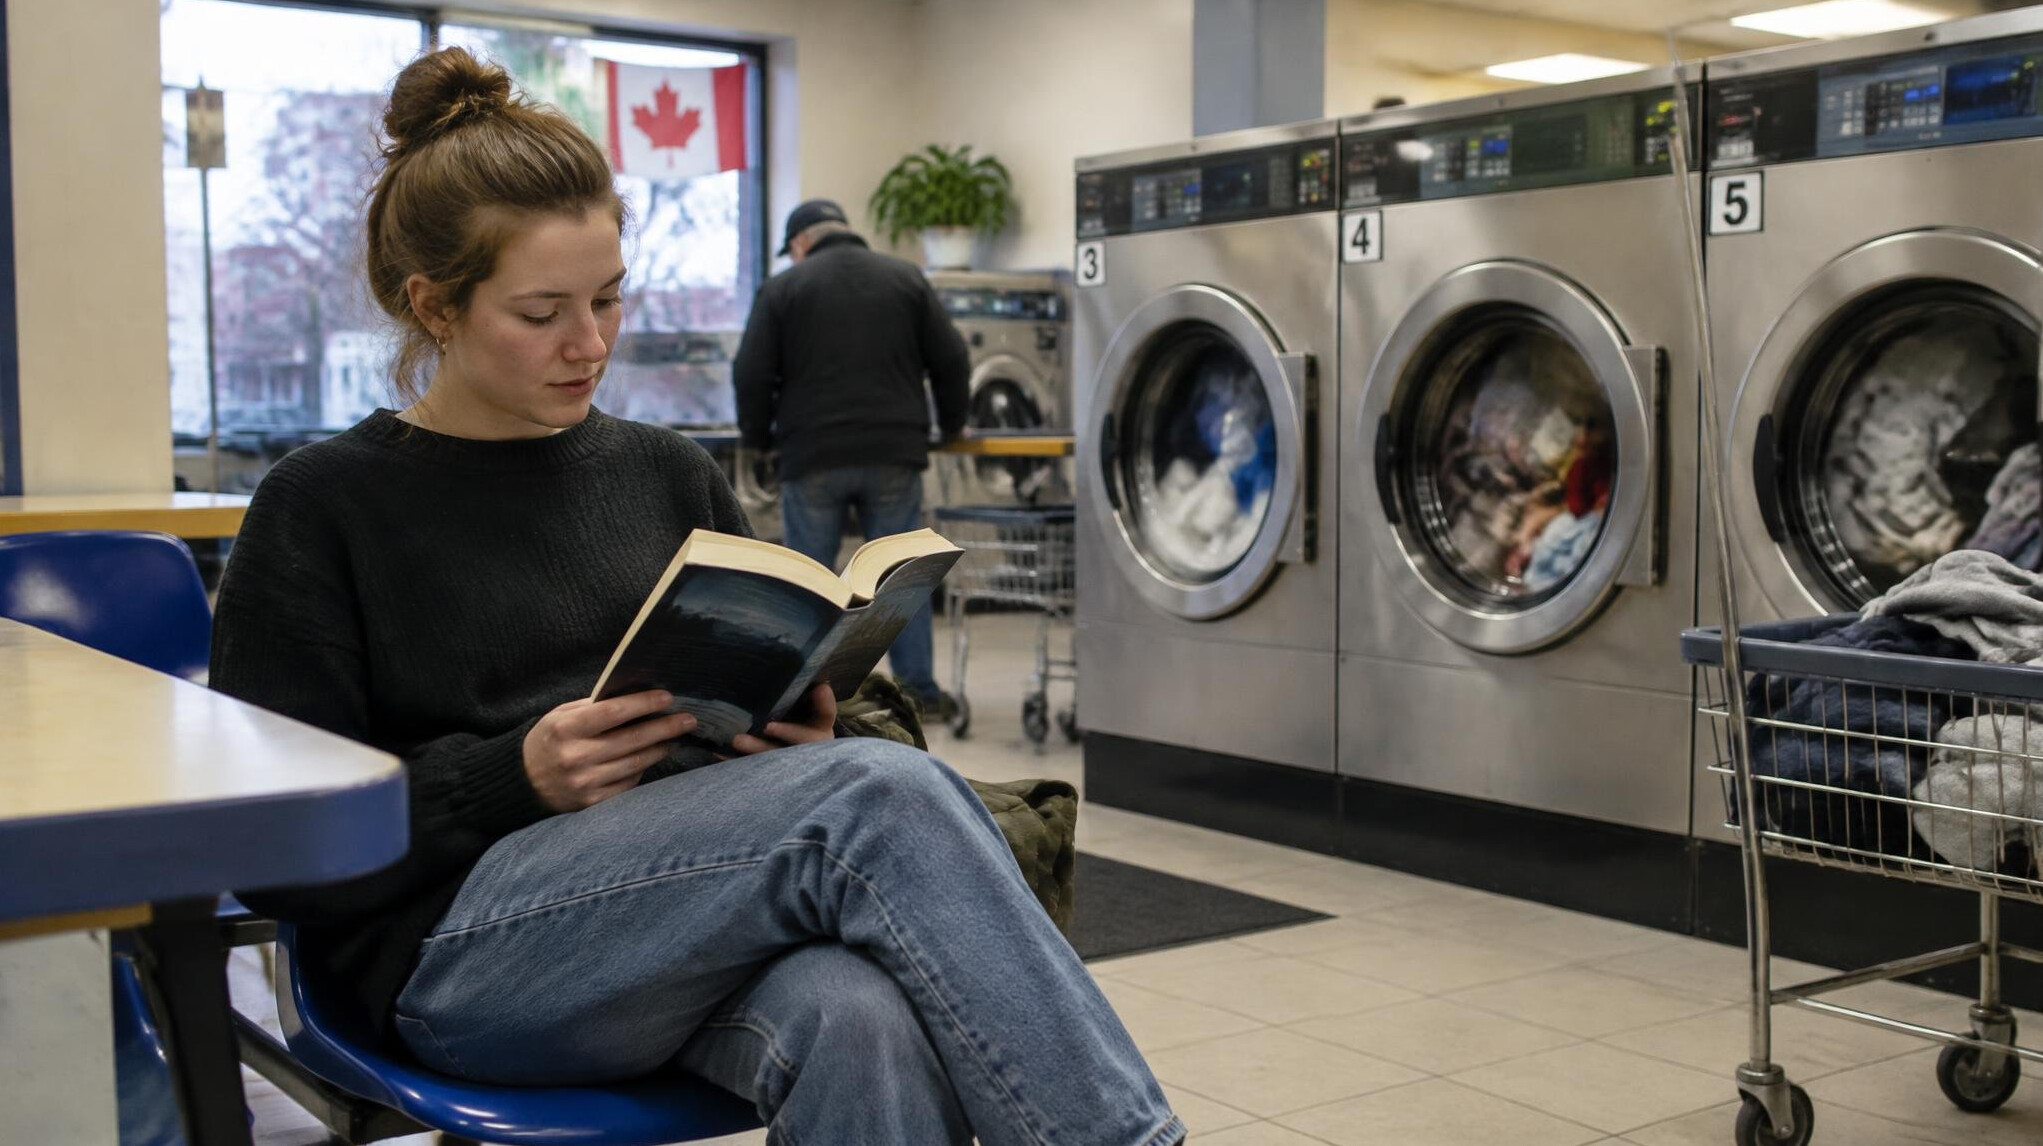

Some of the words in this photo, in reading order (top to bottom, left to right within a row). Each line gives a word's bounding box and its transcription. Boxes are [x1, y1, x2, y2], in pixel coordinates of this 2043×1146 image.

[1724, 181, 1748, 225] 5
[1352, 218, 1370, 256] 4
[1084, 248, 1098, 280] 3
